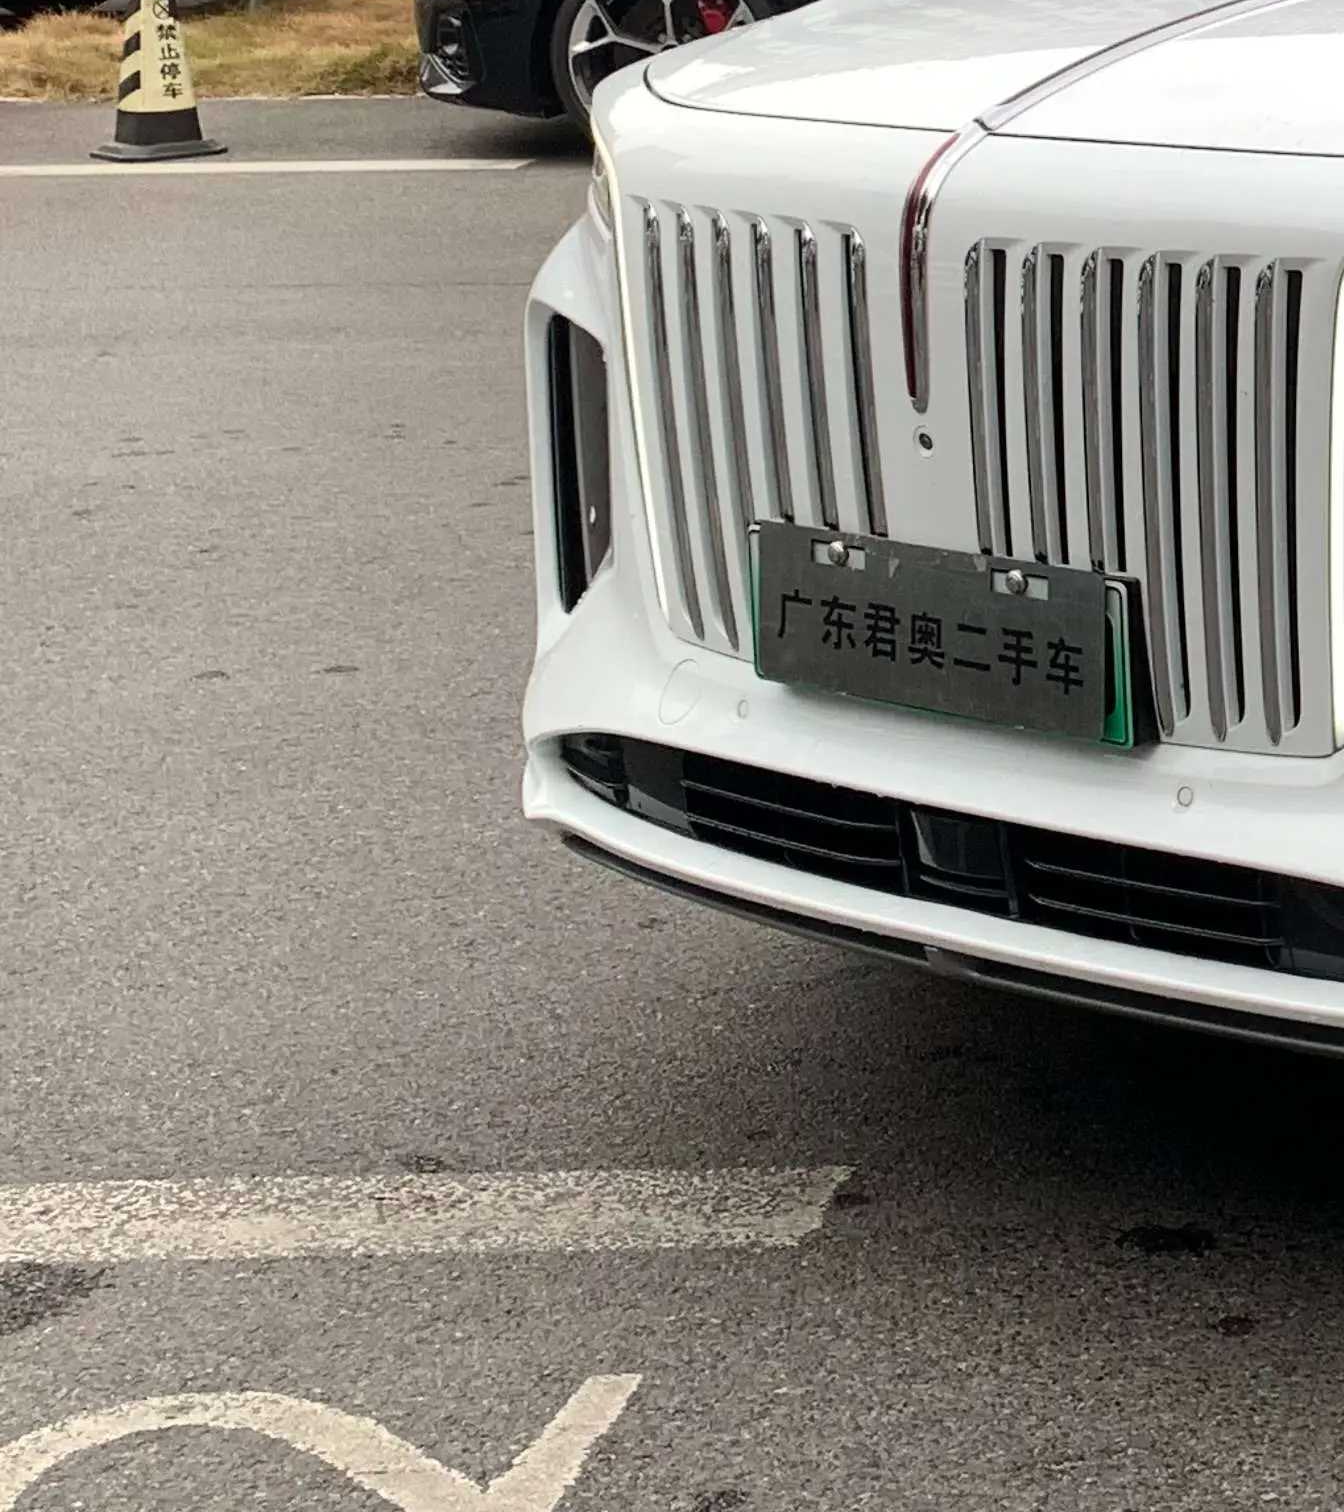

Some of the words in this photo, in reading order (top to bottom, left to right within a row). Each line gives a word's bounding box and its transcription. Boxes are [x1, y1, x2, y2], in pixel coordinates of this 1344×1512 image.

[157, 24, 183, 99] 禁止停车
[778, 590, 1084, 694] 广东君奥二手车
